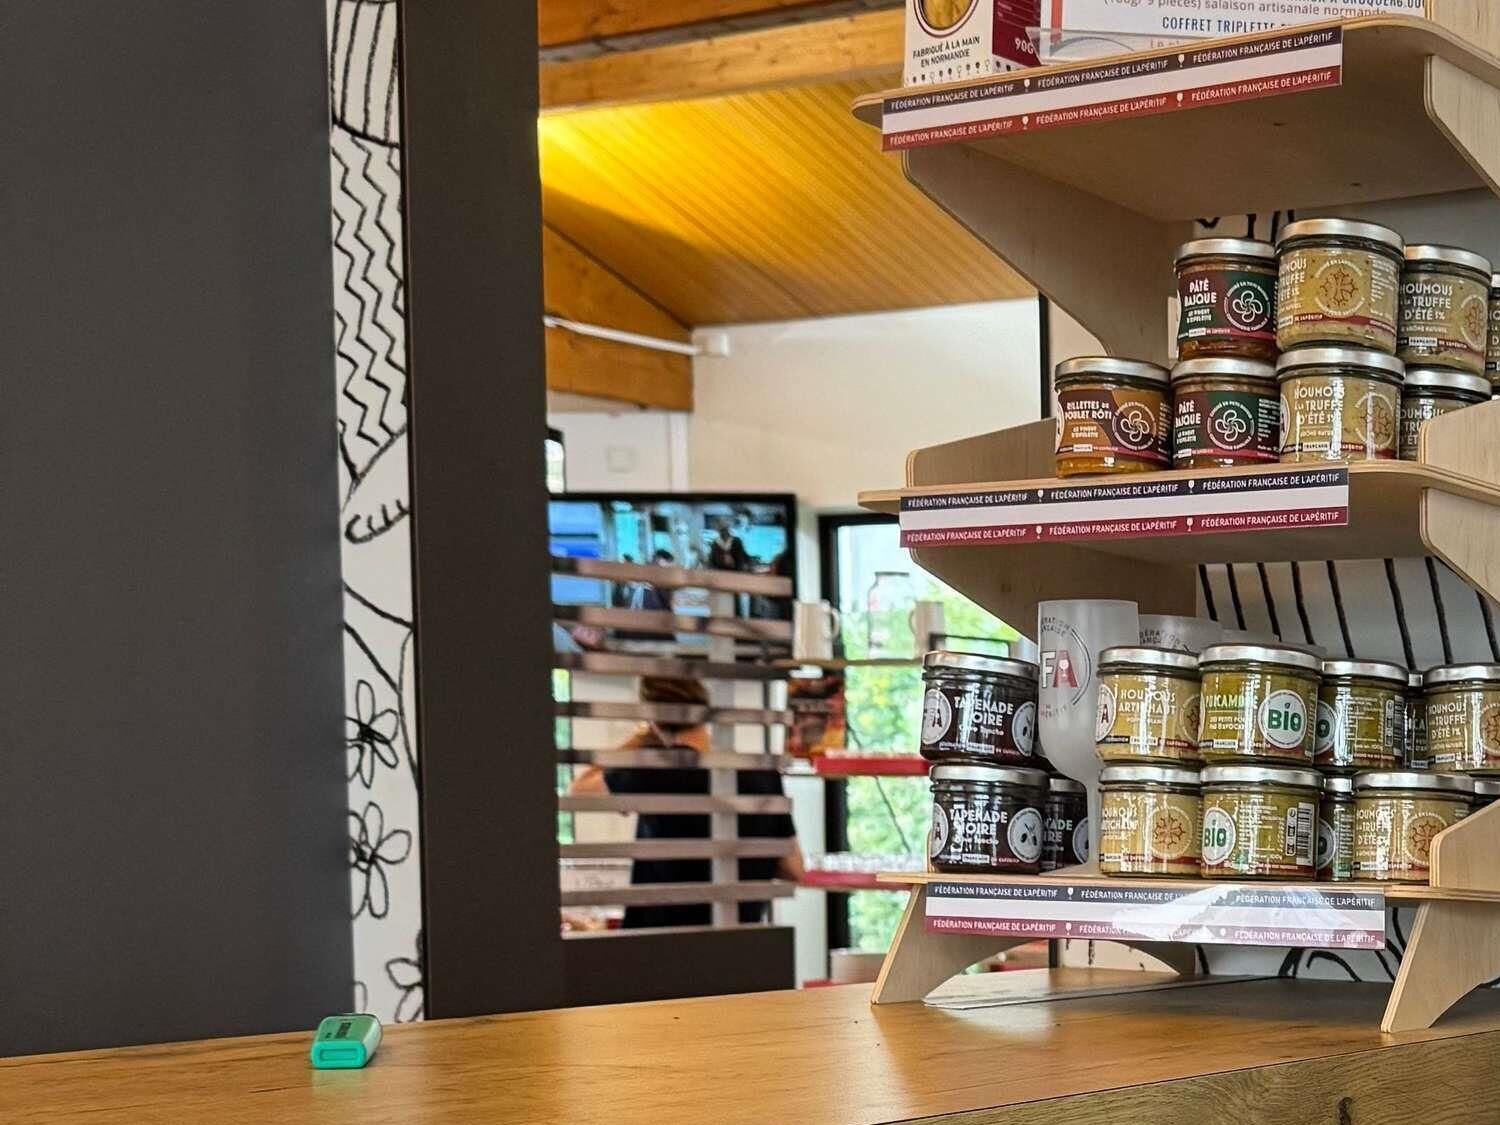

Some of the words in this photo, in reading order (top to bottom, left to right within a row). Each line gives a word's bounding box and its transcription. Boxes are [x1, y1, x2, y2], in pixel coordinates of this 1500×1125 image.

[1260, 2, 1319, 14] artisanale
[1162, 17, 1211, 31] COFFRET
[962, 36, 981, 47] MAIN
[931, 49, 970, 66] NORMANDIE
[1412, 296, 1452, 309] TRUFFE
[1091, 409, 1112, 420] RÔTI
[1118, 701, 1176, 715] ARTIHAUT
[962, 709, 1003, 726] OIRE
